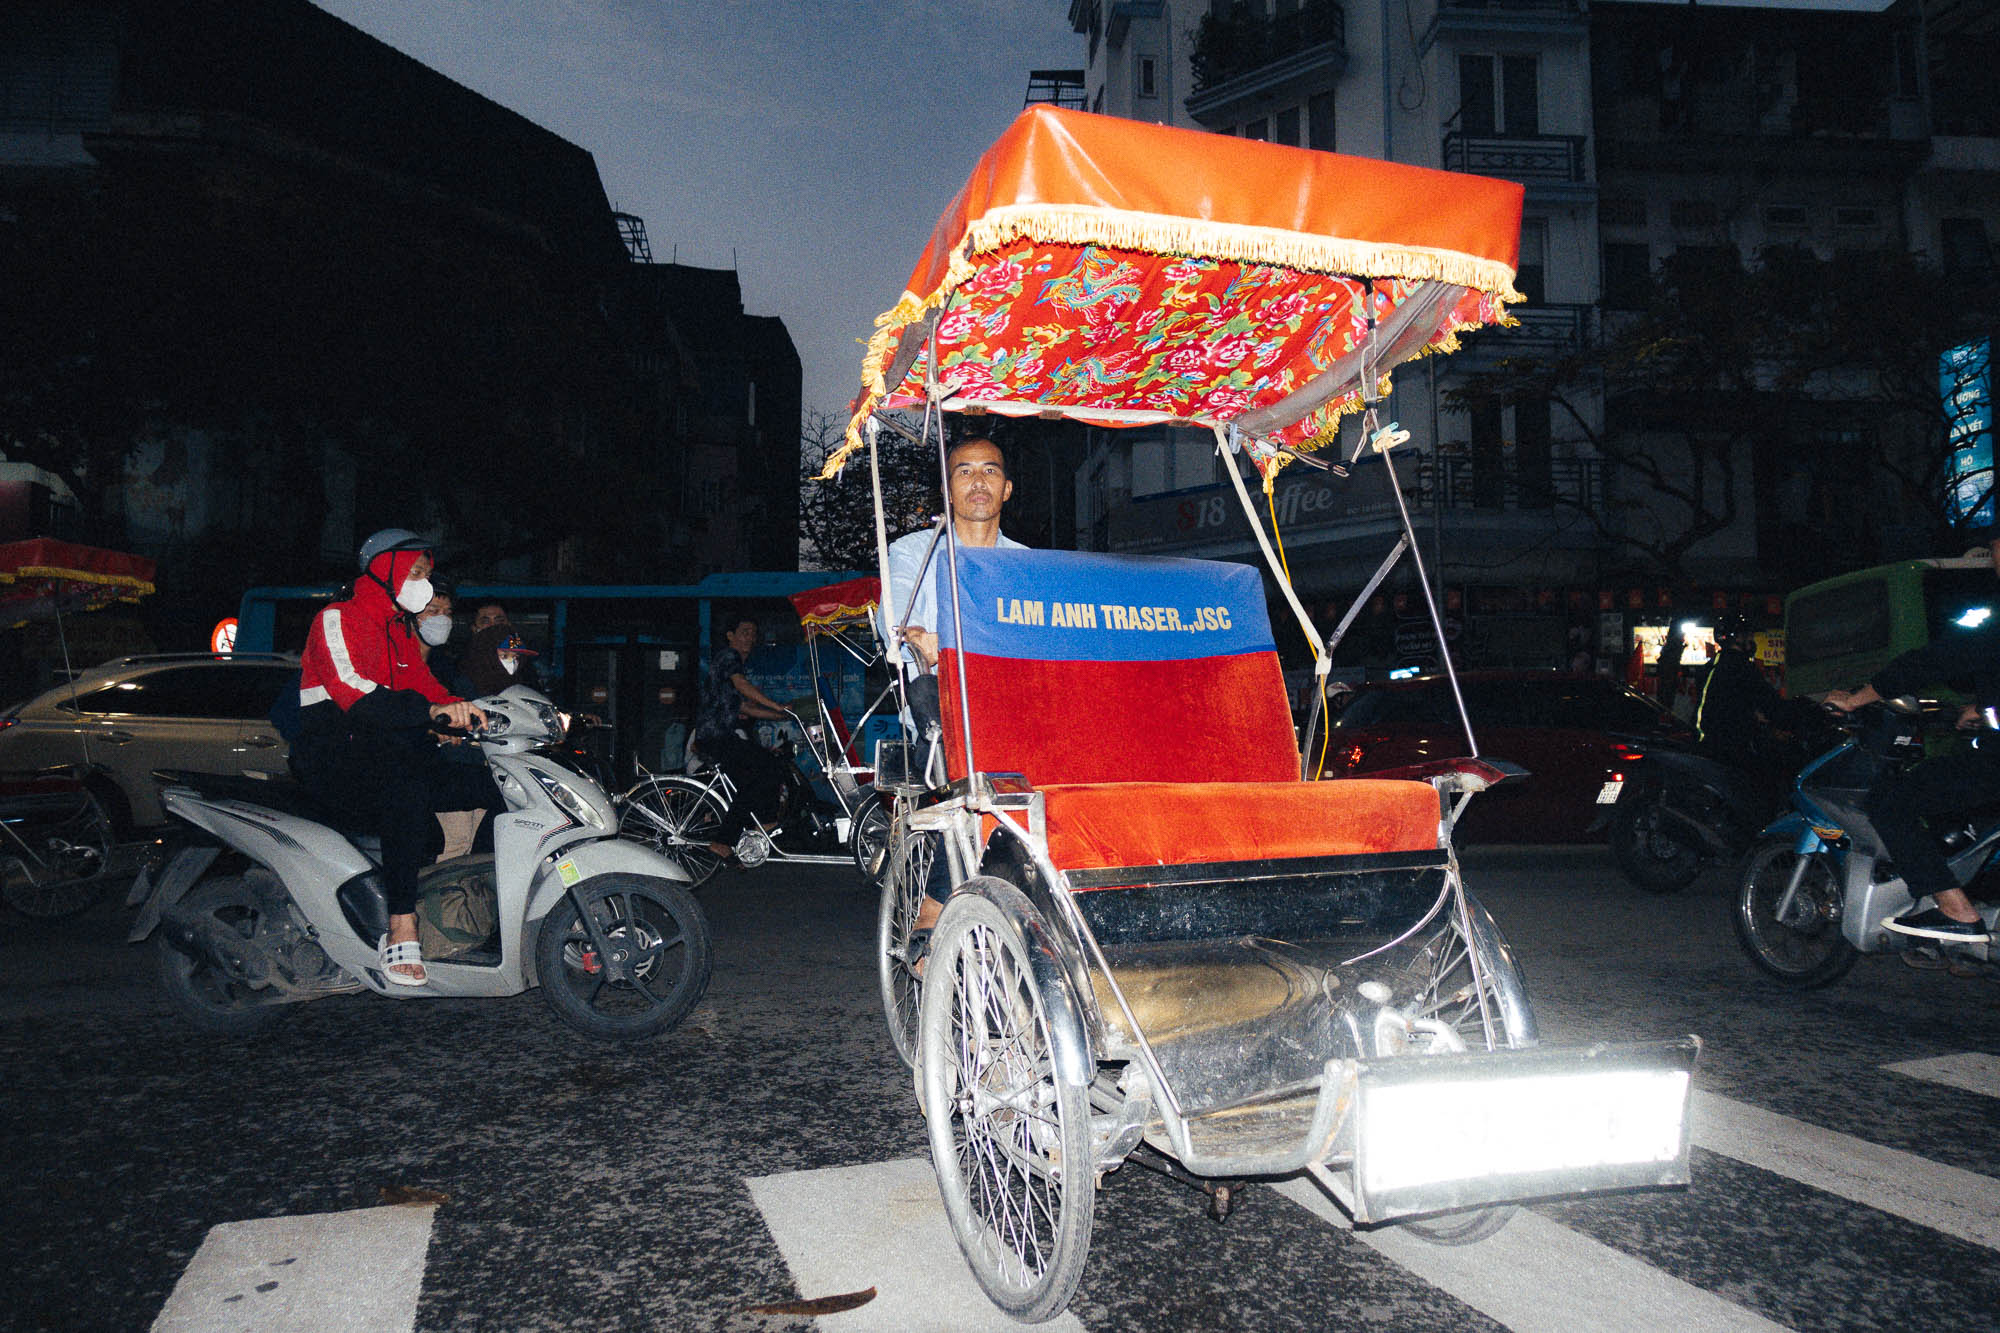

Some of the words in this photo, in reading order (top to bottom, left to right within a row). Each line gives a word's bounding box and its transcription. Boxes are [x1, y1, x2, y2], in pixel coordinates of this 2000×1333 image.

[1177, 496, 1226, 531] S18
[1244, 481, 1334, 525] Coffee
[997, 598, 1045, 626] LAM
[1051, 603, 1097, 629] ANH
